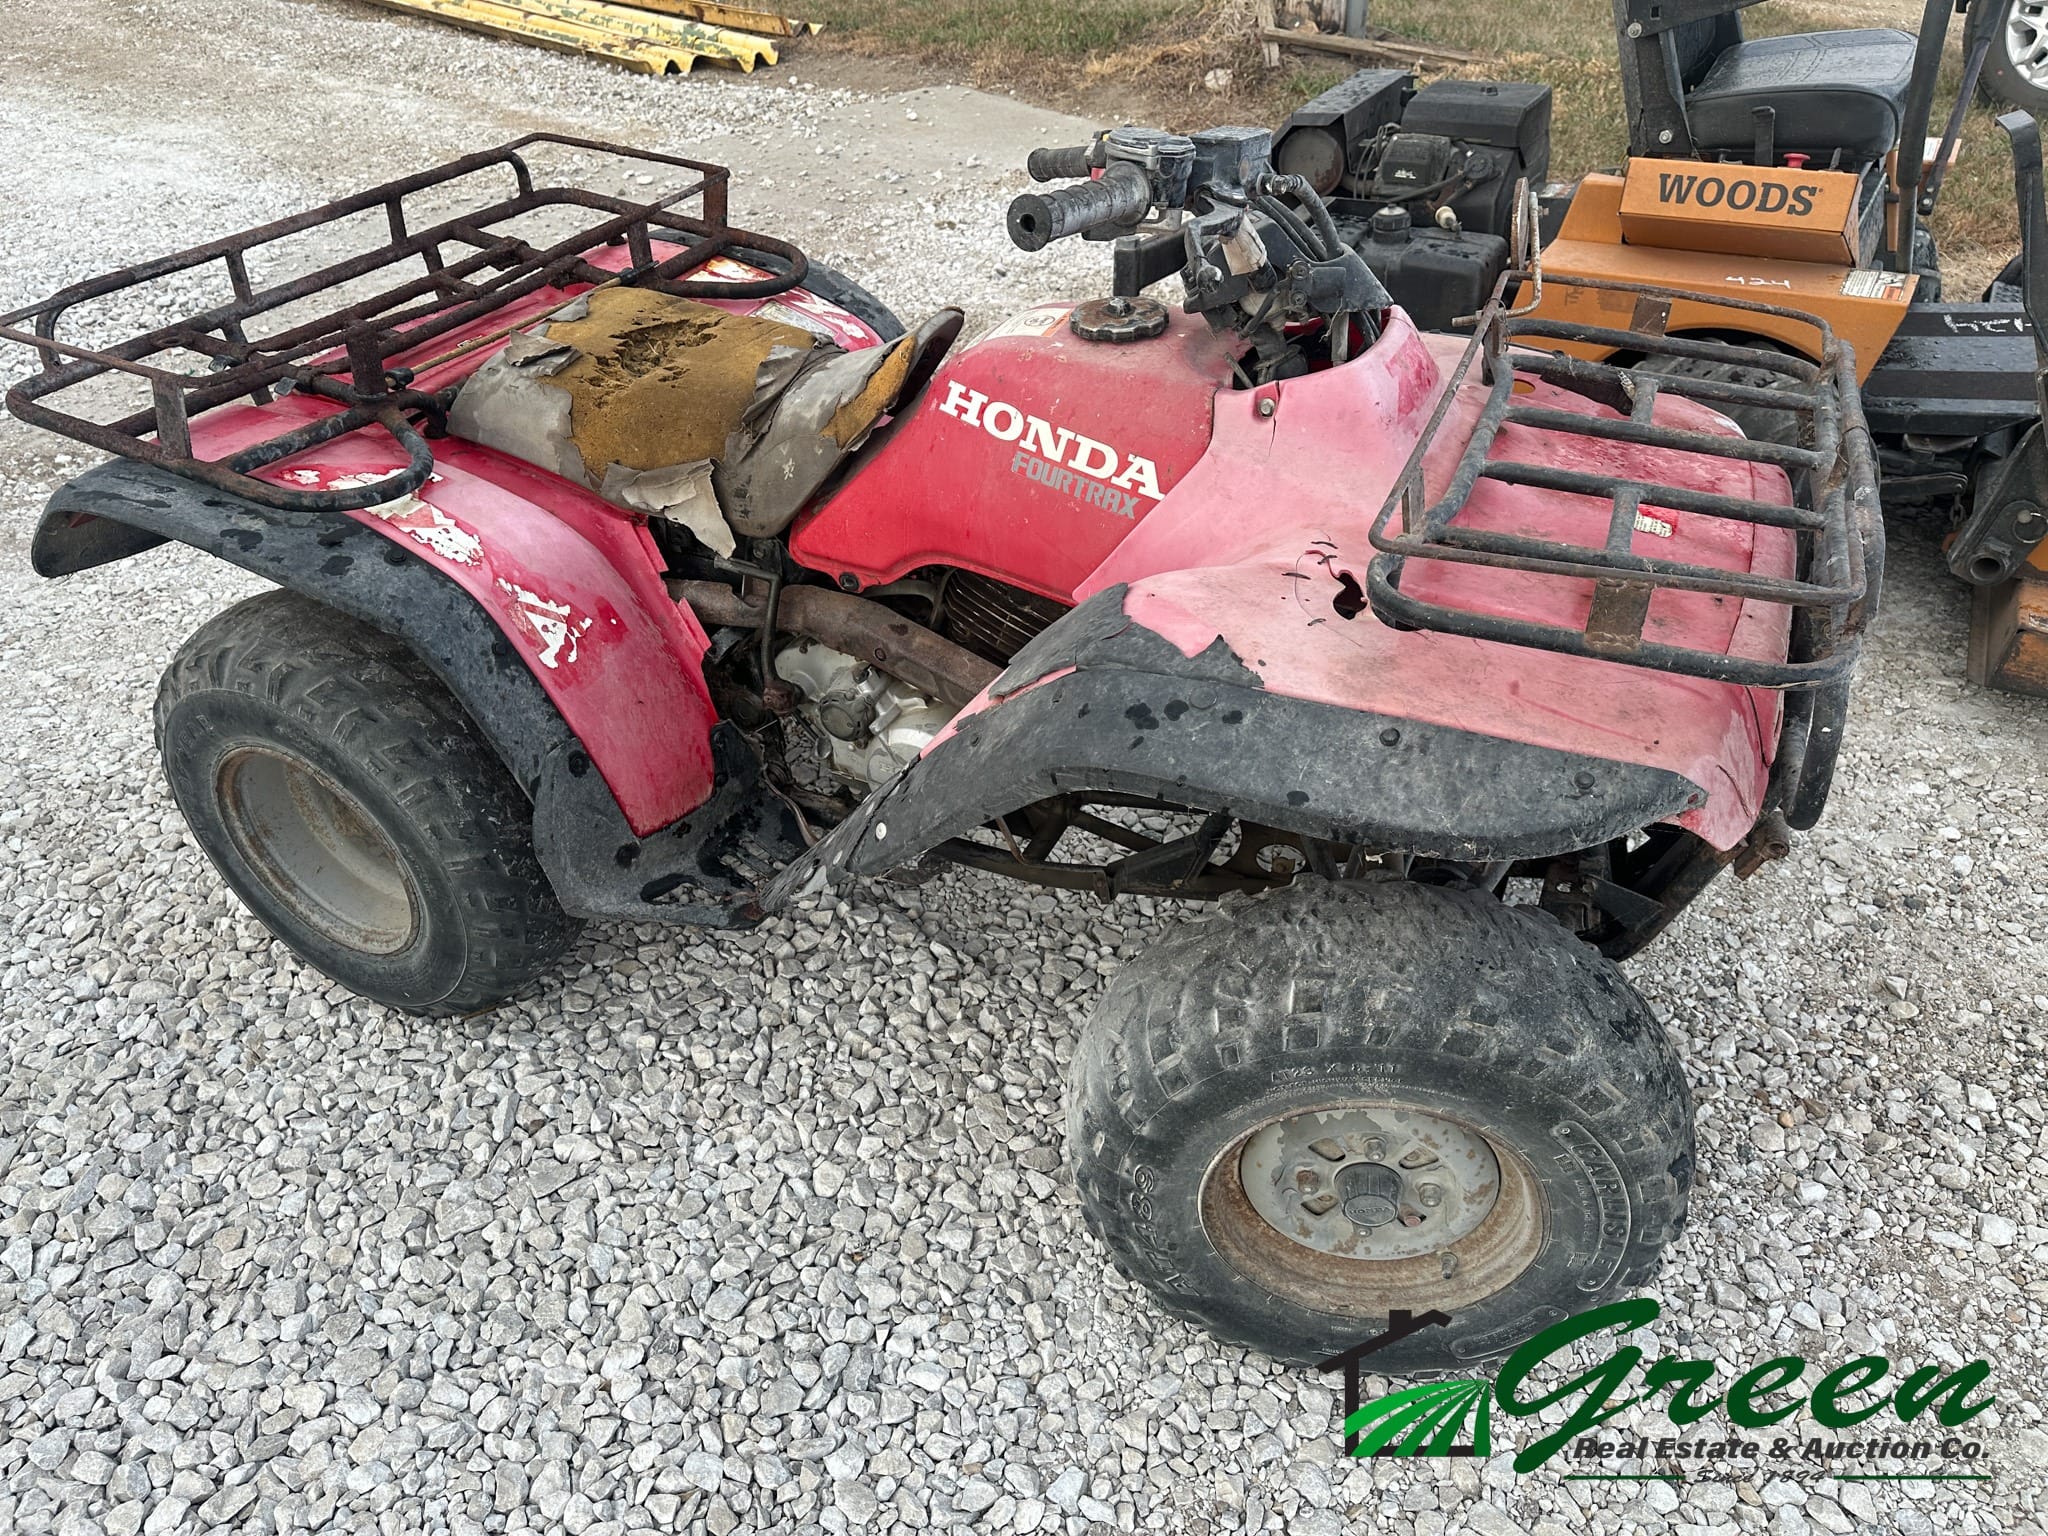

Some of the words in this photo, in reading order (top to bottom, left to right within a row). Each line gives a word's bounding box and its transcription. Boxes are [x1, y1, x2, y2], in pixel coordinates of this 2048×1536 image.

[1659, 173, 1817, 216] WOODS
[1725, 276, 1791, 289] 424
[939, 379, 1166, 501] HONDA
[1011, 451, 1142, 519] FOURTRAX
[1570, 1143, 1627, 1270] CARLISLE
